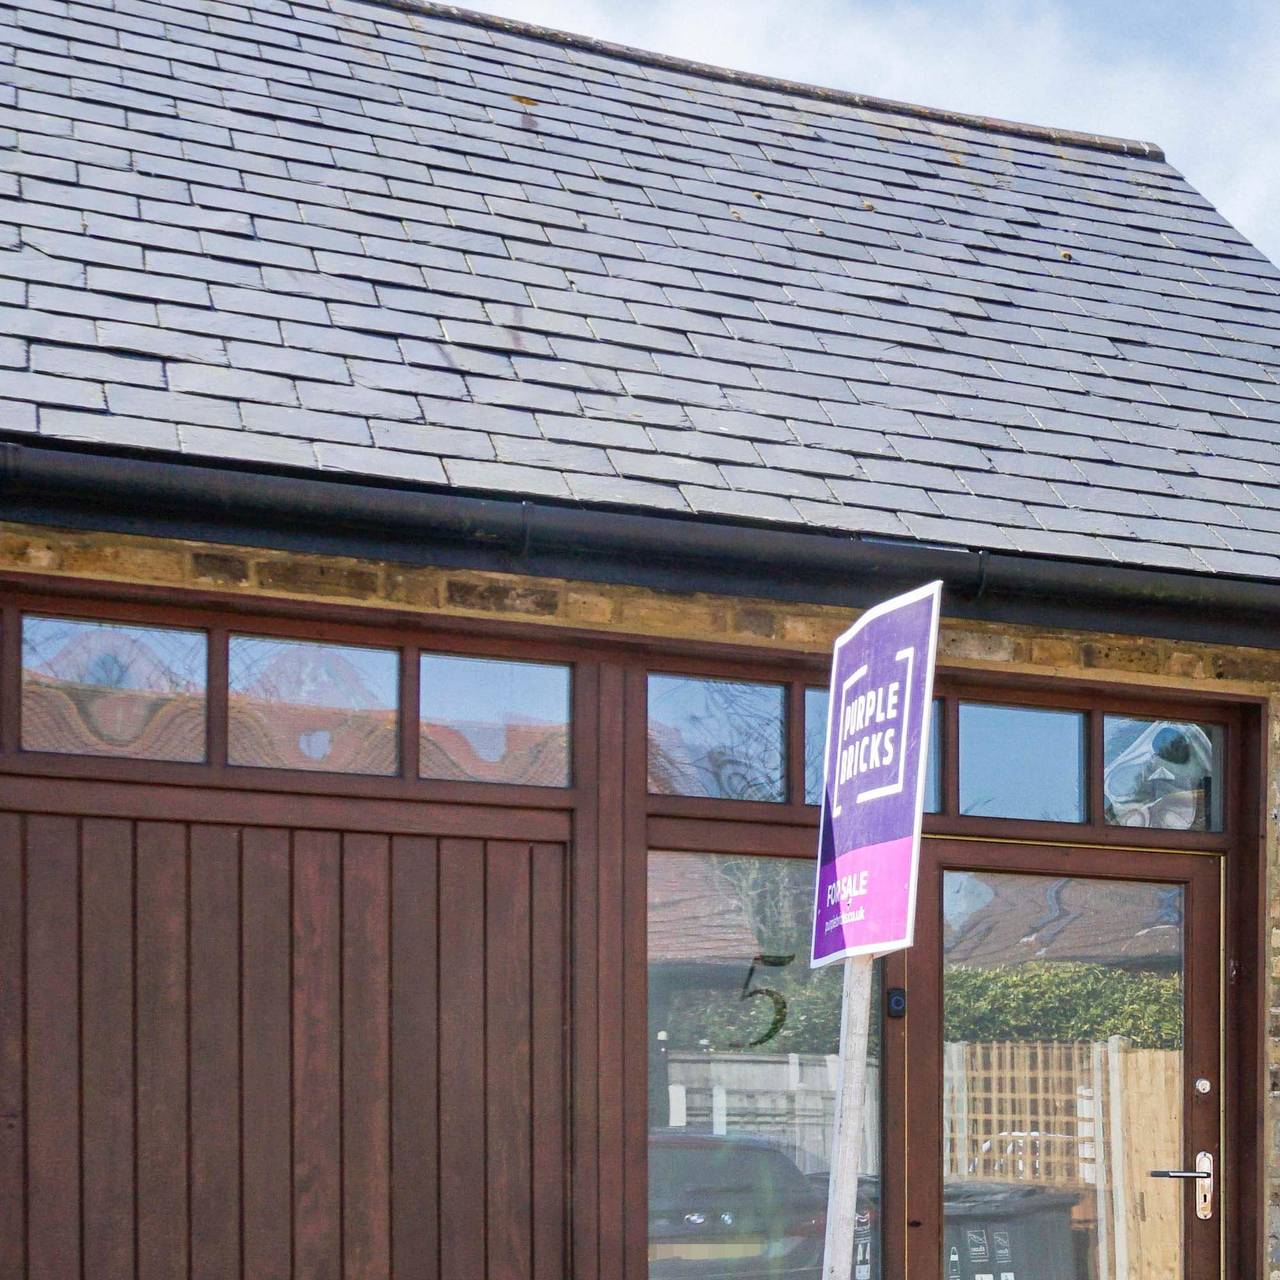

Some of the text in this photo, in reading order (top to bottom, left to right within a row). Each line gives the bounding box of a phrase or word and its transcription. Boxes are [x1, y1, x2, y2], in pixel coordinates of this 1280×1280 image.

[843, 681, 899, 741] PURPLE
[839, 727, 896, 785] BRICKS
[840, 870, 869, 901] SALE
[729, 953, 796, 1049] 5
